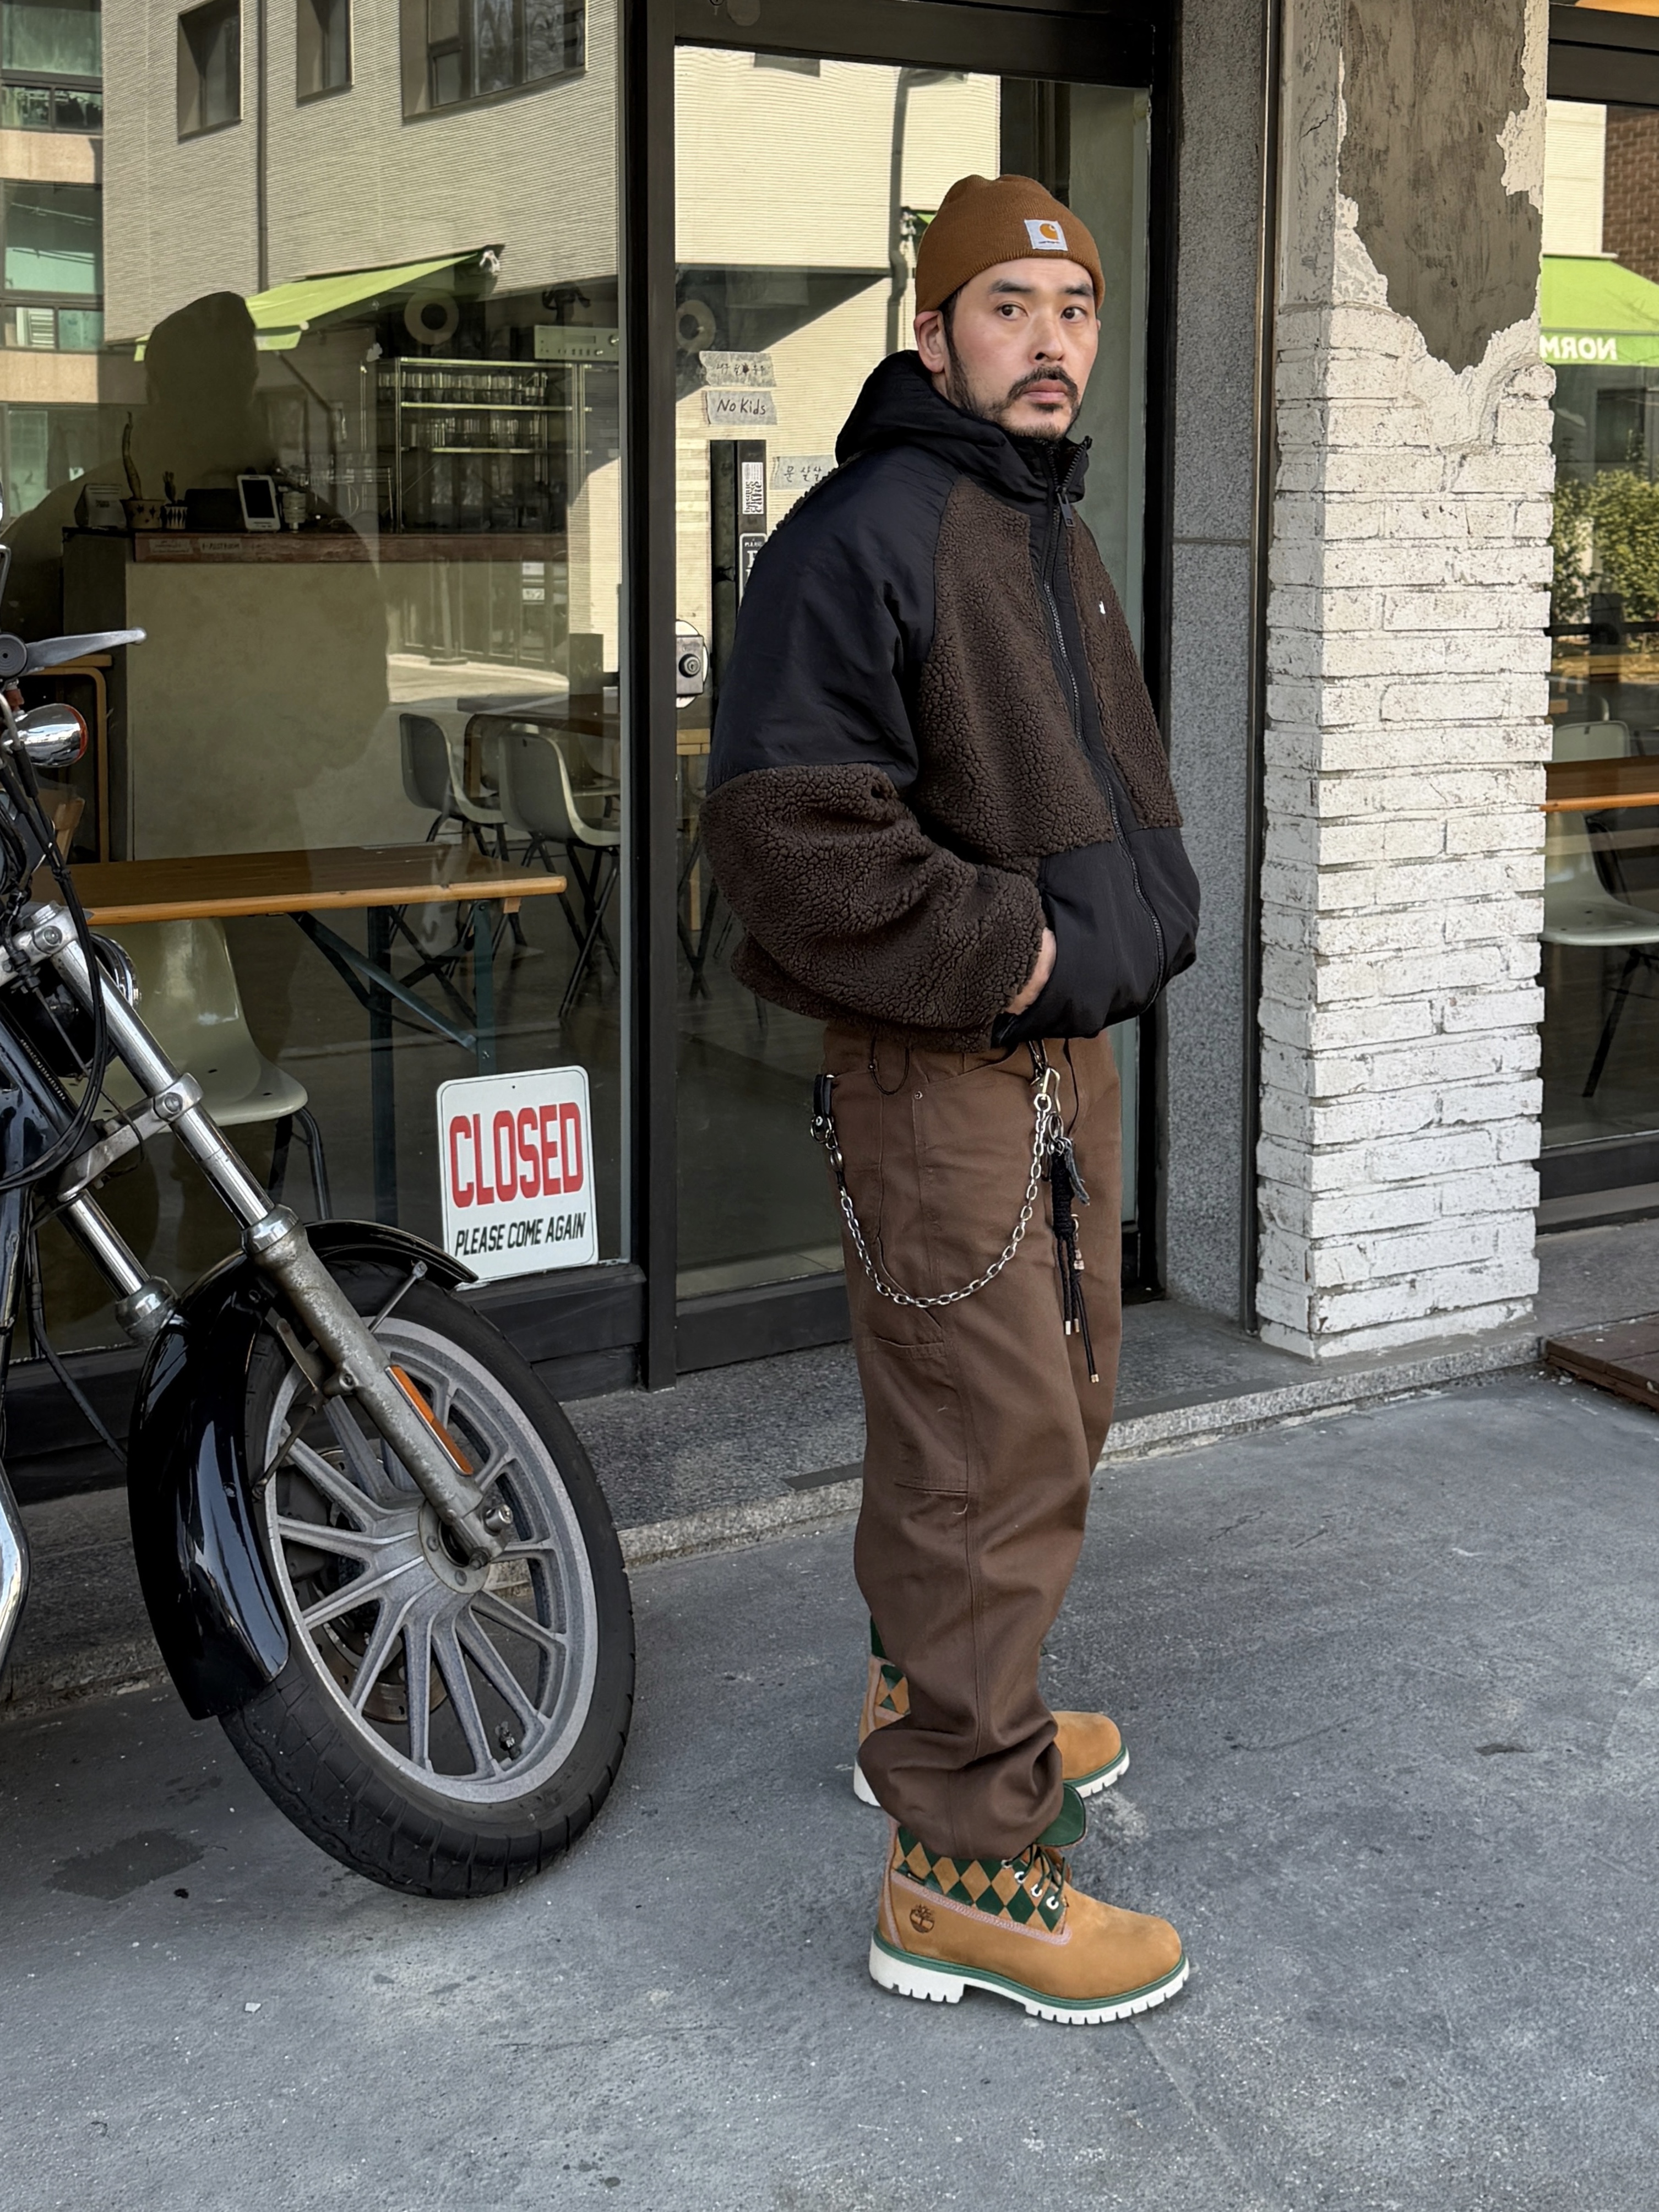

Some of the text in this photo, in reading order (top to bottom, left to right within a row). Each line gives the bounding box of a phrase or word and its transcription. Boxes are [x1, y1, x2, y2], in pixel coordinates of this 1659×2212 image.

[717, 398, 766, 415] No Kids
[449, 1102, 584, 1208] CLOSED
[455, 1212, 586, 1257] PLEASE COME AGAIN
